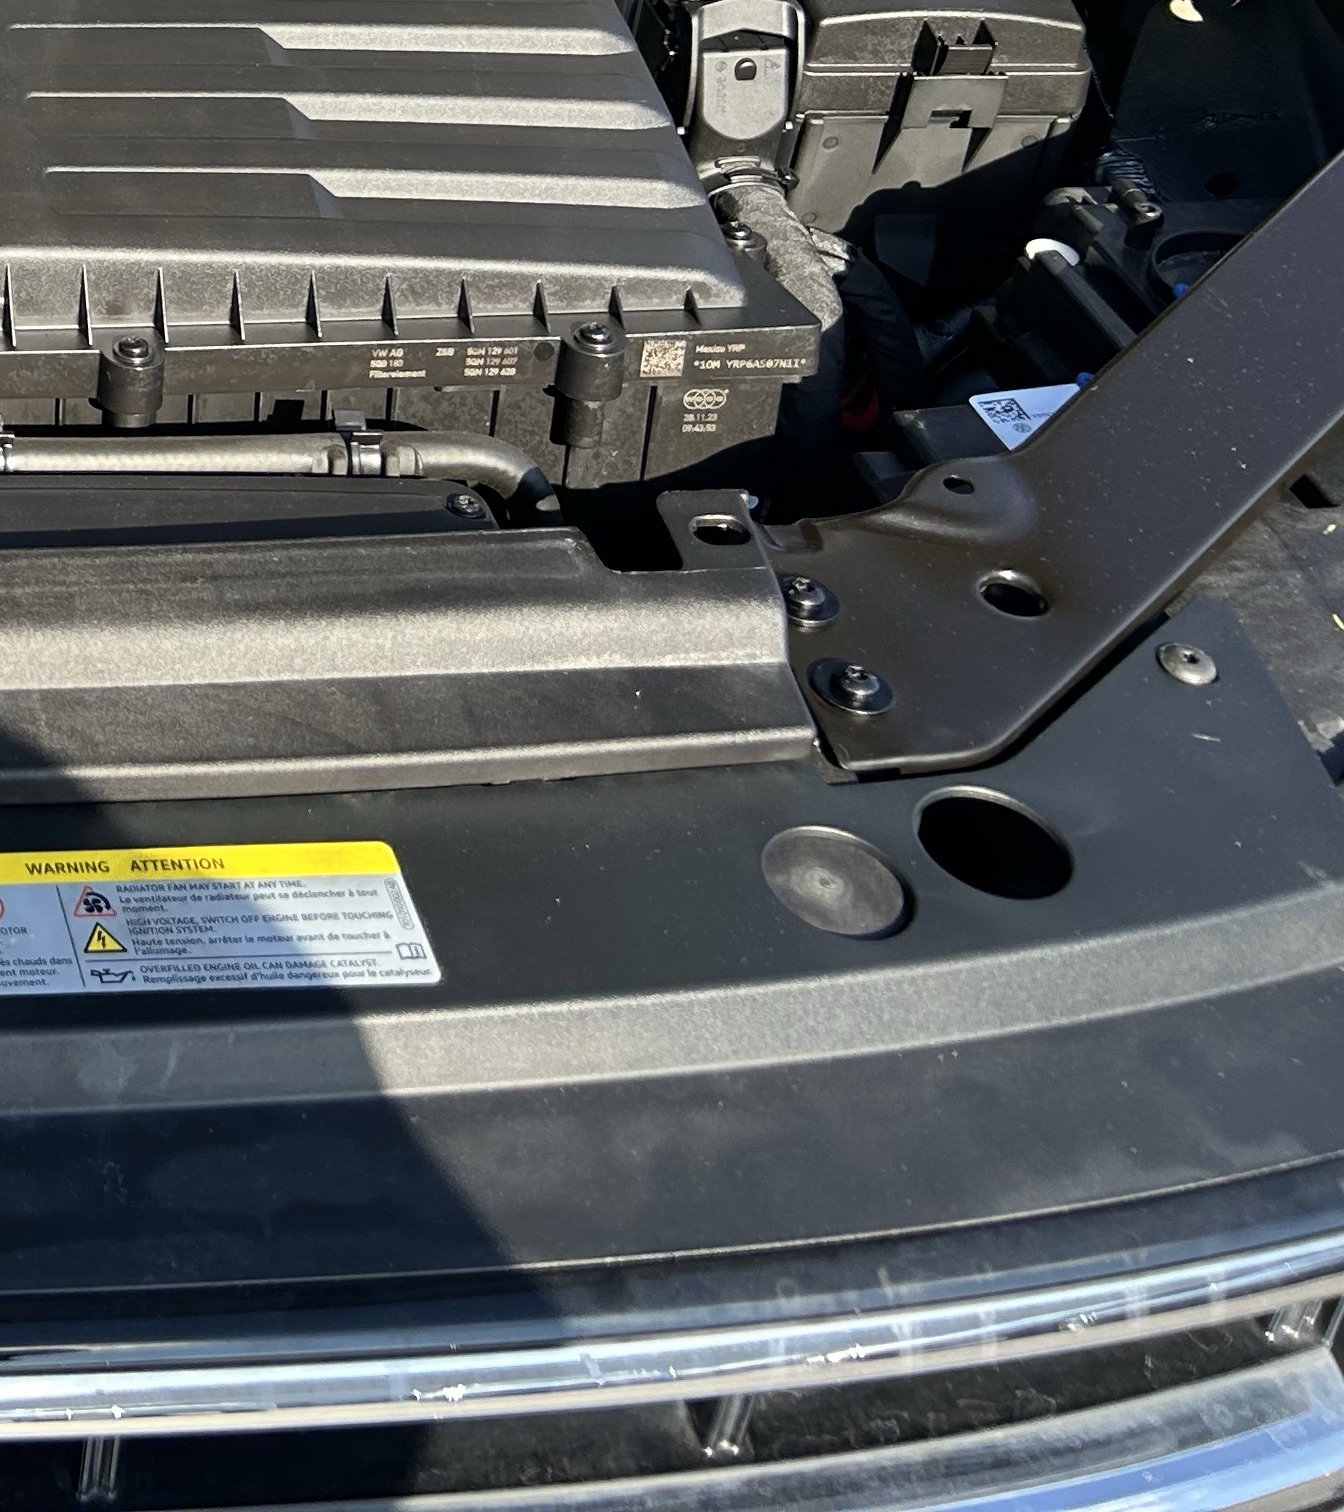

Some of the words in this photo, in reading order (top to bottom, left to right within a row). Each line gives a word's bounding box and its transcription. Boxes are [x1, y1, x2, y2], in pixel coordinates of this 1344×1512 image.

[372, 349, 387, 357] VW
[389, 349, 404, 357] AG
[727, 344, 746, 353] YRP
[485, 368, 499, 376] 129
[25, 860, 110, 875] WARNING
[129, 857, 226, 873] ATTENTION
[116, 884, 166, 893] RADIATOR
[167, 883, 187, 892] FAN
[189, 883, 211, 891] MAY
[212, 882, 240, 891] START
[244, 881, 255, 889] AT
[119, 896, 131, 904] Le
[134, 895, 188, 903] ventilateur
[190, 894, 203, 902] de
[205, 893, 249, 902] radiateur
[253, 892, 276, 902] peut
[356, 889, 379, 897] tout
[125, 918, 151, 926] HIGH
[200, 915, 239, 924] SWITCH
[241, 915, 259, 923] OFF
[262, 914, 299, 923] ENGINE
[301, 912, 340, 921] BEFORE
[342, 910, 394, 920] TOUCHING
[127, 926, 173, 935] IGNITION
[132, 938, 162, 946] Haute
[245, 935, 255, 943] le
[256, 934, 294, 943] moteur
[296, 932, 324, 942] avant
[327, 932, 340, 941] de
[342, 931, 381, 940] toucher
[13, 957, 48, 966] chauds
[49, 957, 73, 965] dans
[140, 964, 201, 974] OVERFILLED
[203, 962, 241, 972] ENGINE
[244, 962, 260, 970] OIL
[262, 961, 284, 970] CAN
[286, 960, 327, 969] DAMAGE
[143, 975, 207, 984] Remplissage
[209, 973, 247, 982] excessif
[287, 970, 339, 981] dangereux
[342, 970, 365, 979] pour
[367, 969, 377, 977] le
